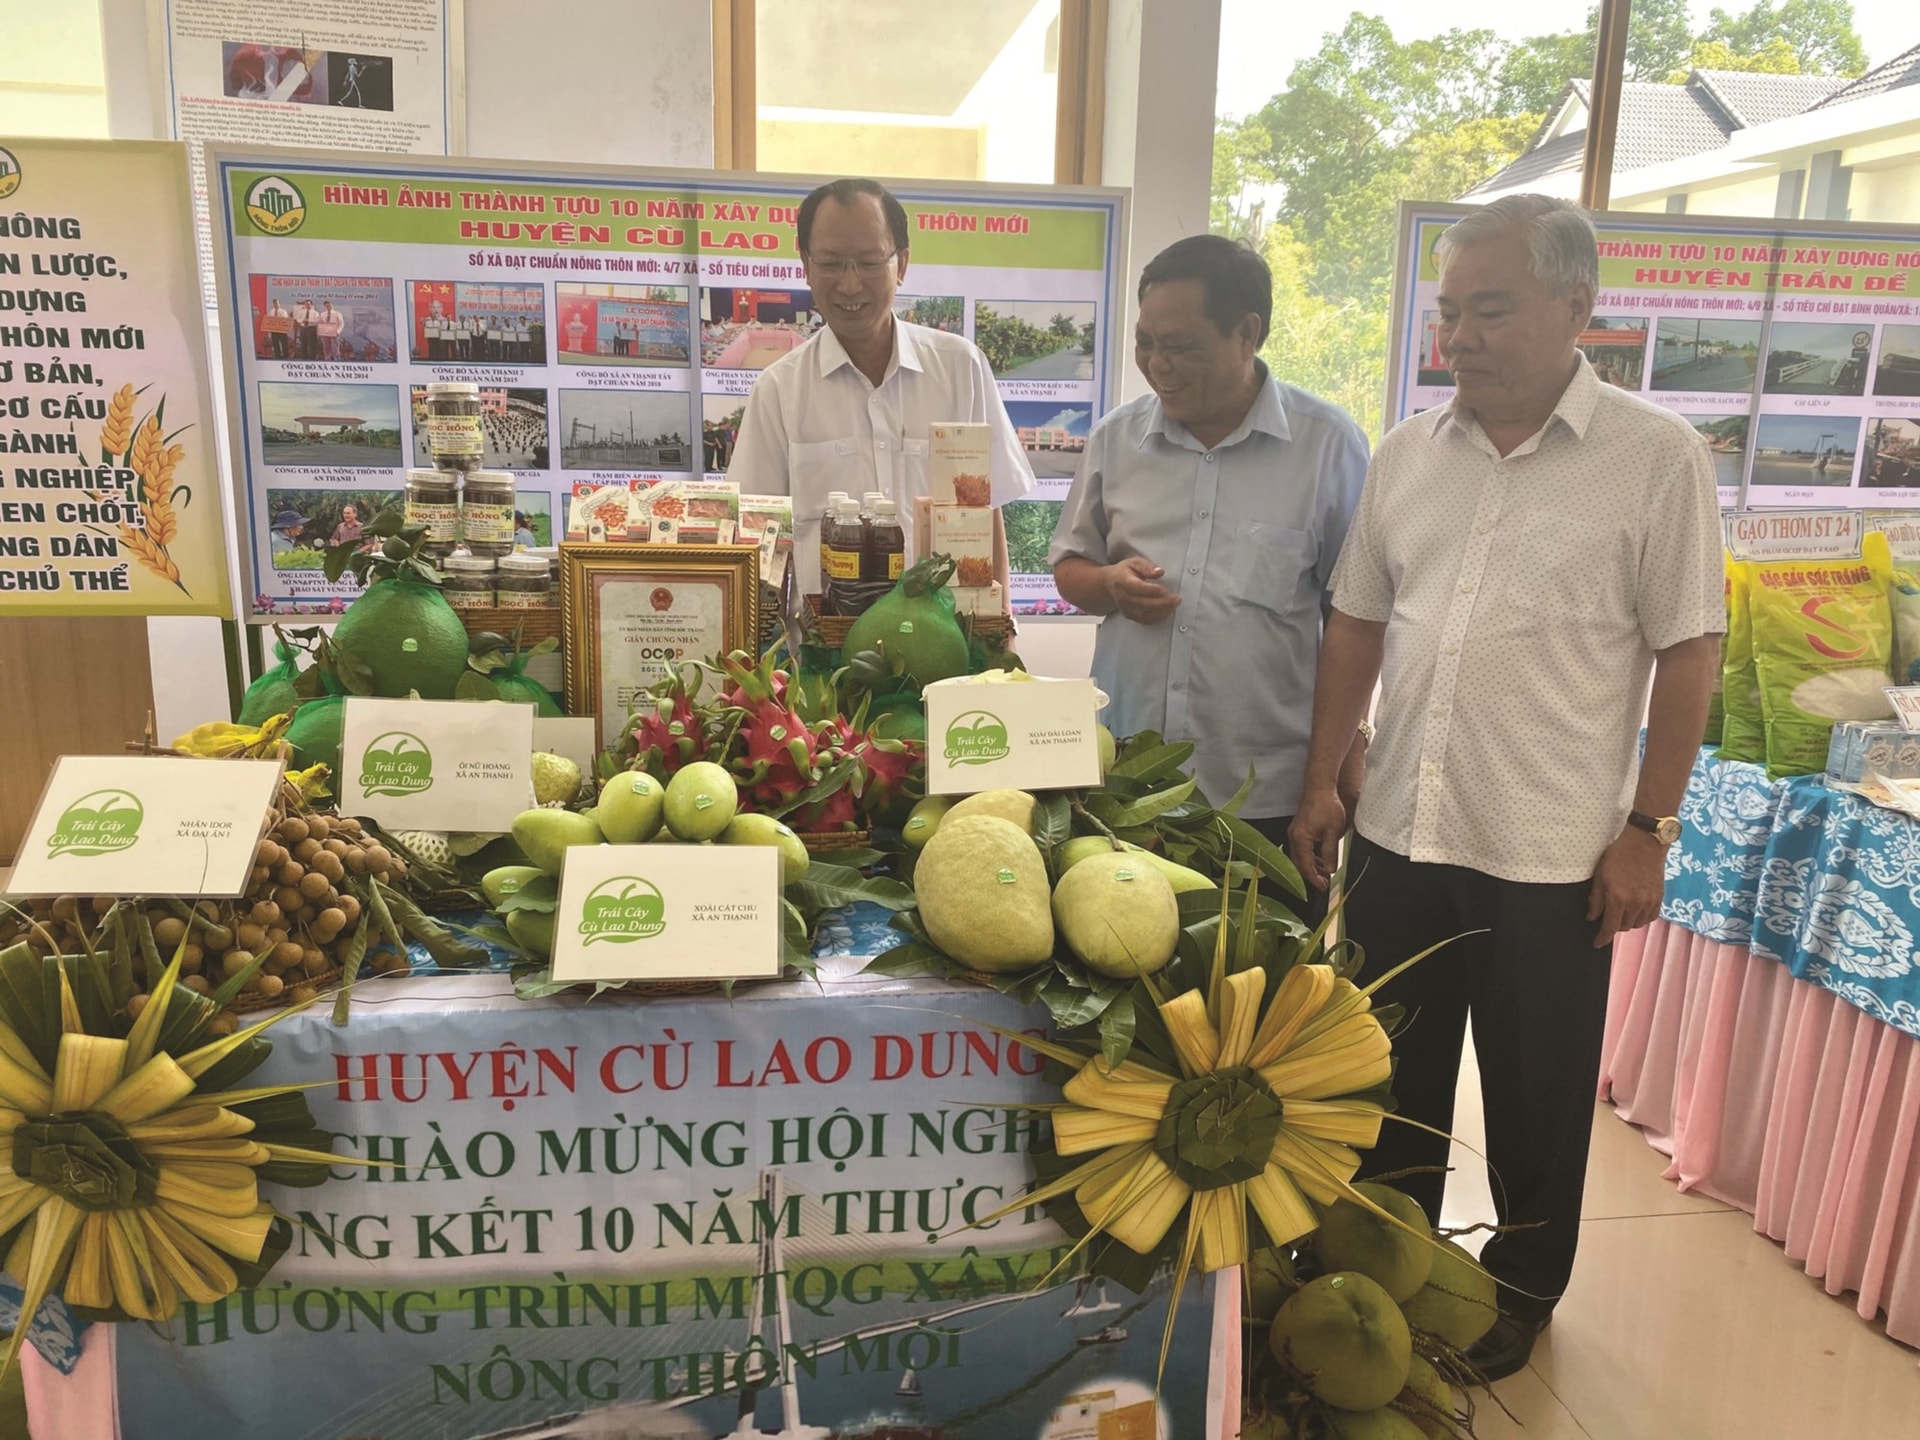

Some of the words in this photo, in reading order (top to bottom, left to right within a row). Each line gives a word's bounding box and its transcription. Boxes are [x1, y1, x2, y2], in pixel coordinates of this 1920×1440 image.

[324, 183, 388, 206] HÌNH
[398, 184, 451, 208] ẢNH
[460, 189, 545, 213] THÀNH
[554, 196, 600, 217] TỰU
[610, 199, 639, 217] 10
[648, 199, 704, 220] NĂM
[713, 202, 760, 223] XÂY
[459, 219, 611, 247] HUYỆN
[626, 224, 685, 247] CÙ
[700, 230, 779, 251] LAO
[917, 211, 977, 232] THÔN
[984, 213, 1030, 235] MỚI
[31, 252, 128, 281] LƯỢC,
[468, 251, 484, 266] SỐ
[487, 251, 502, 267] XÃ
[505, 254, 527, 270] ĐẠT
[530, 252, 567, 270] CHUẨN
[570, 254, 602, 271] NÔNG
[605, 256, 635, 272] THÔN
[637, 256, 662, 273] MỚI:
[664, 258, 680, 274] 4/7
[683, 258, 699, 275] XÃ
[709, 257, 723, 276] SỐ
[726, 260, 749, 277] TIÊU
[752, 260, 770, 278] CHÍ
[773, 263, 793, 281] ĐẠT
[1597, 240, 1662, 259] THÀNH
[1668, 243, 1706, 264] TỰU
[1713, 245, 1736, 261] 10
[1742, 246, 1786, 264] NĂM
[1793, 247, 1832, 265] XÂY
[1837, 249, 1889, 270] DỰNG
[1634, 268, 1752, 288] HUYỆN
[1764, 270, 1853, 290] TRẦN
[1864, 272, 1907, 291] ĐỀ
[81, 325, 145, 350] MỚI
[24, 356, 103, 387] BẢN,
[41, 391, 107, 420] CẤU
[15, 464, 135, 494] NGHIỆP
[0, 502, 45, 523] EN
[56, 496, 146, 525] CHỐT,
[1737, 518, 1768, 545] GẠO
[1770, 516, 1813, 540] THƠM
[1815, 516, 1833, 538] ST
[1836, 515, 1851, 537] 24
[50, 533, 118, 557] DÂN
[70, 563, 129, 591] THỂ
[641, 648, 684, 659] OCOP
[945, 747, 959, 758] Cù
[962, 747, 980, 757] Lao
[982, 746, 1009, 757] Dung
[957, 735, 975, 747] Trái
[978, 735, 997, 748] Cây
[360, 774, 376, 785] Cù
[378, 775, 399, 786] Lao
[401, 775, 432, 787] Dung
[374, 760, 395, 772] Trái
[397, 761, 419, 775] Cây
[50, 833, 68, 846] Cù
[70, 834, 96, 845] Lao
[98, 834, 137, 847] Dung
[71, 820, 97, 832] Trái
[98, 820, 127, 833] Cây
[580, 920, 599, 933] Cù
[601, 921, 626, 932] Lao
[628, 921, 665, 934] Dung
[598, 906, 622, 918] Trái
[625, 906, 650, 921] Cây
[333, 1041, 579, 1112] HUYỆN
[600, 1028, 694, 1094] CÙ
[713, 1036, 853, 1088] LAO
[869, 1028, 1048, 1082] DUNG
[327, 1121, 516, 1184] CHÀO
[536, 1110, 749, 1177] MỪNG
[768, 1106, 890, 1172] HỘI
[907, 1107, 1042, 1157] NGH
[290, 1210, 393, 1261] NG
[411, 1196, 552, 1260] KẾT
[574, 1205, 634, 1253] 10
[654, 1187, 805, 1249] NĂM
[822, 1177, 1003, 1245] THỰC
[170, 1280, 440, 1347] HƯƠNG
[458, 1271, 673, 1331] TRÌNH
[692, 1262, 887, 1322] MTQG
[903, 1245, 1034, 1304] XÂY
[429, 1344, 621, 1405] NÔNG
[641, 1334, 820, 1402] THÔN
